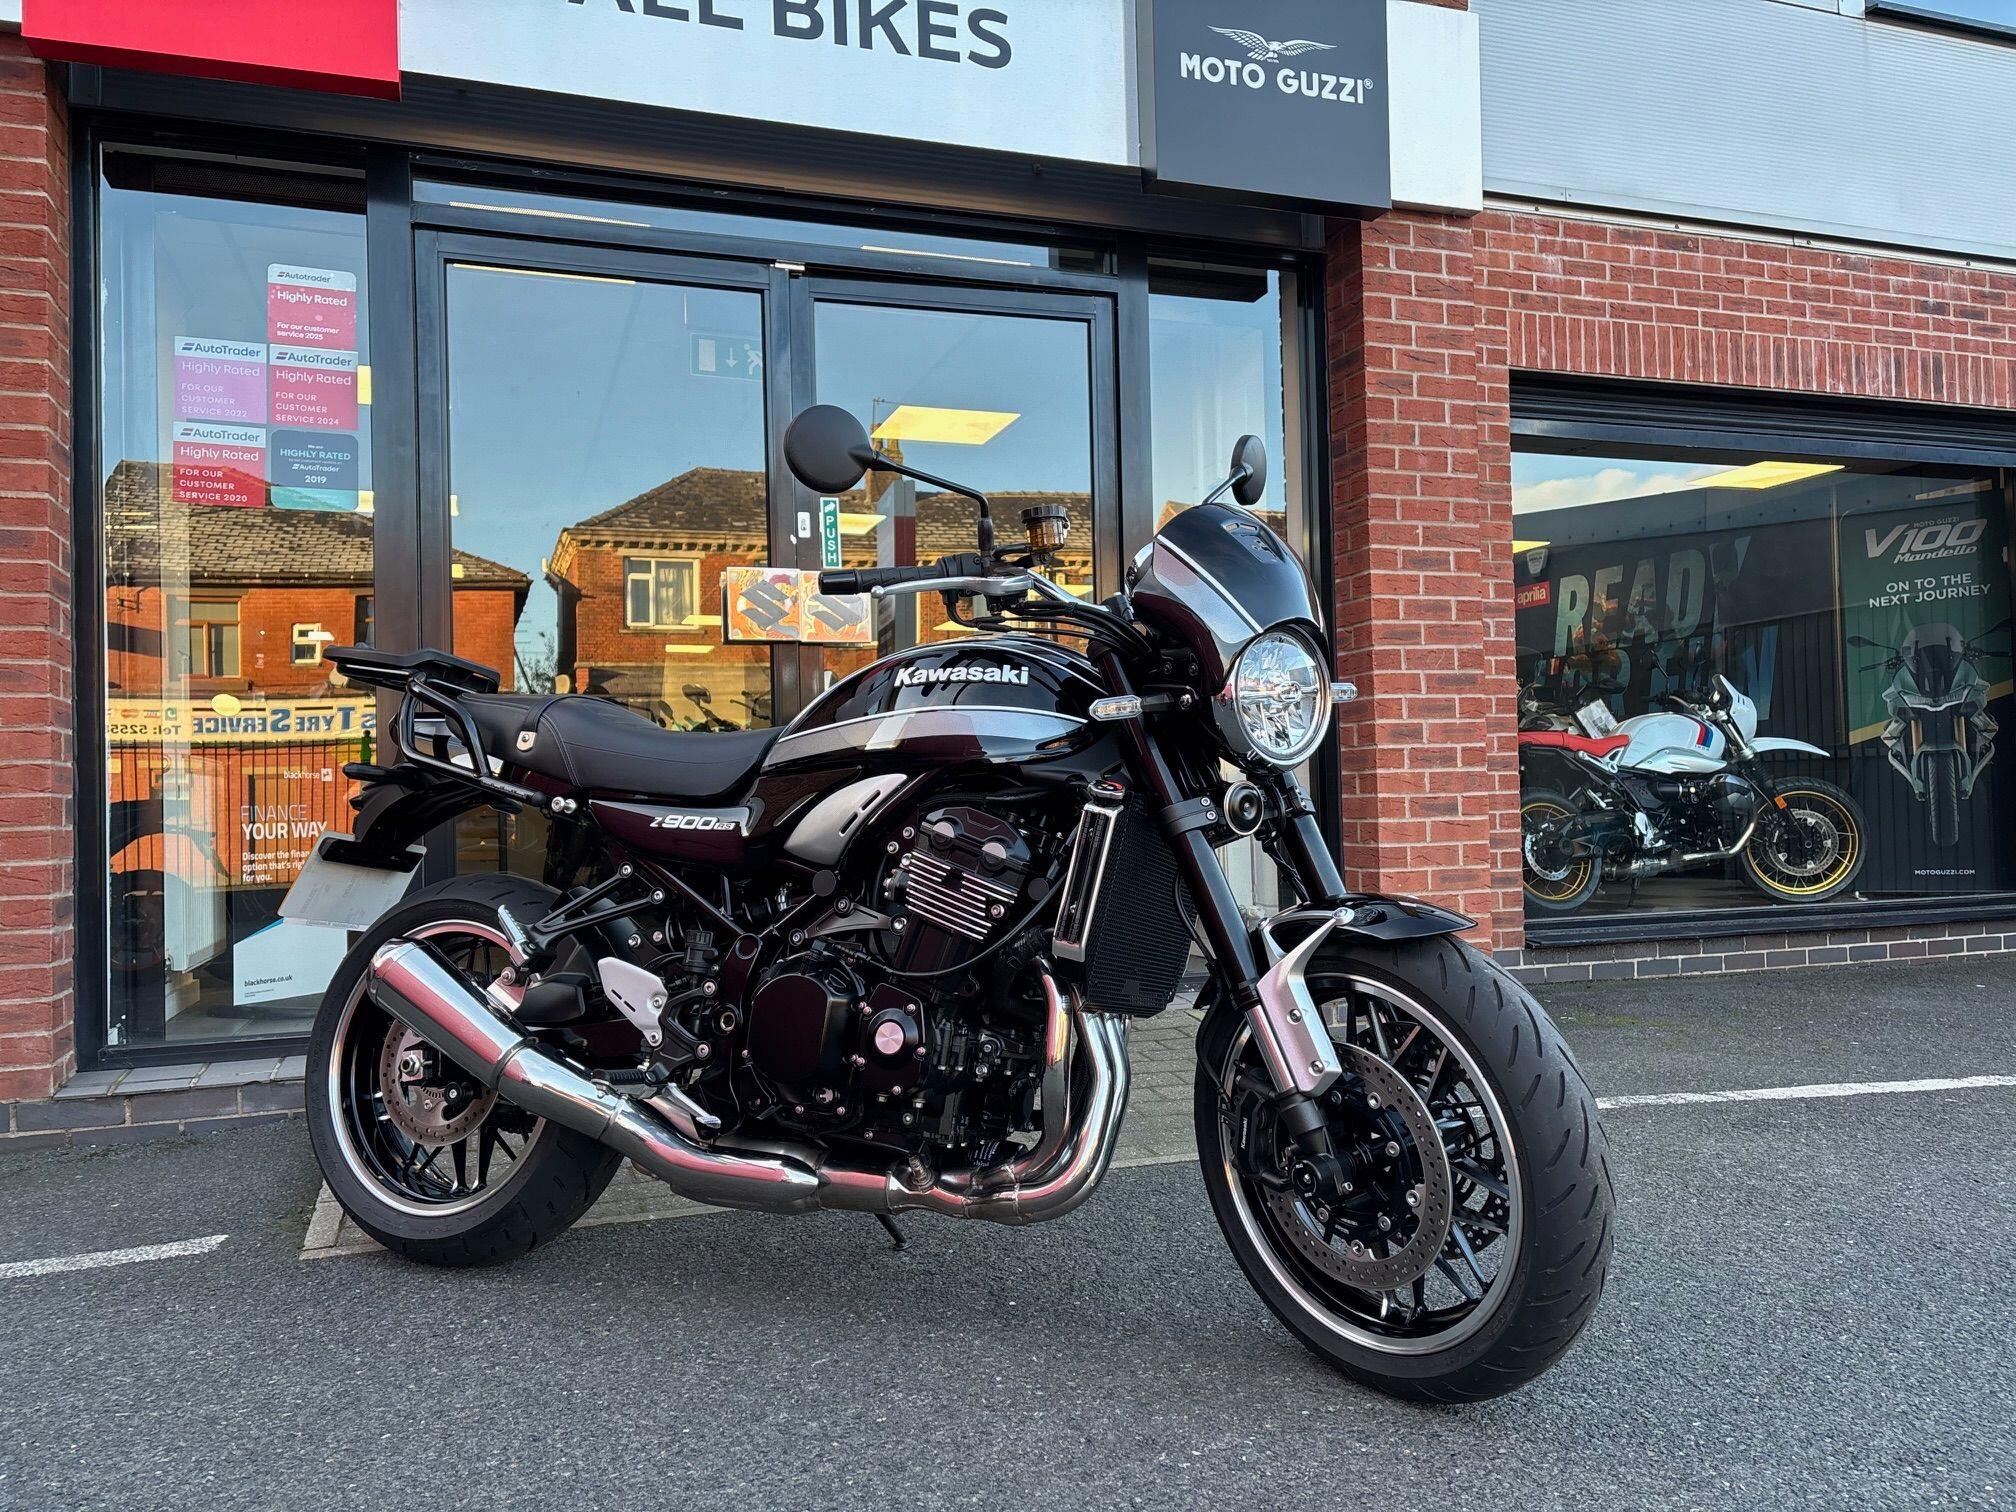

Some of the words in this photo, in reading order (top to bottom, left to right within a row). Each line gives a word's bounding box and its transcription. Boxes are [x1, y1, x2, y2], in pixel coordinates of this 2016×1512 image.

[568, 0, 743, 30] LL
[773, 0, 1012, 69] BIKES
[1180, 52, 1266, 89] MOTO
[285, 272, 331, 283] Autotrader
[277, 290, 313, 304] Highly
[314, 295, 347, 306] Rated
[276, 321, 289, 329] For
[290, 323, 303, 331] our
[304, 324, 339, 334] customer
[276, 330, 304, 338] service
[304, 332, 323, 340] 2025
[194, 343, 261, 357] AutoTrader
[287, 352, 353, 367] AutoTrader
[182, 361, 221, 375] Highly
[223, 364, 260, 377] Rated
[276, 370, 314, 384] Highly
[316, 373, 352, 386] Rated
[181, 383, 201, 391] FOR
[203, 384, 224, 393] OUR
[181, 394, 236, 405] CUSTOMER
[275, 391, 295, 400] FOR
[296, 393, 317, 401] OUR
[181, 405, 221, 415] SERVICE
[224, 408, 248, 417] 2022
[275, 402, 328, 414] CUSTOMER
[275, 413, 315, 424] SERVICE
[317, 417, 339, 425] 2024
[193, 428, 260, 442] AutoTrader
[180, 446, 220, 460] Highly
[222, 449, 259, 461] Rated
[280, 448, 318, 458] HIGHLY
[319, 451, 351, 460] RATED
[179, 468, 200, 476] FOR
[202, 470, 223, 478] OUR
[299, 463, 340, 472] AutoTrader
[179, 479, 235, 490] CUSTOMER
[304, 475, 327, 484] 2019
[179, 490, 221, 500] SERVICE
[223, 493, 248, 502] 2020
[1913, 520, 1935, 528] MOTO
[1936, 517, 1960, 525] GUZZI
[825, 515, 837, 563] PUSH
[1865, 519, 1988, 558] V100
[1893, 545, 1978, 564] Mandello
[1886, 581, 1910, 593] ON
[1914, 577, 1936, 589] TO
[1940, 572, 1972, 586] THE
[1517, 585, 1547, 605] aprilia
[1869, 593, 1910, 608] NEXT
[1915, 584, 1991, 602] JOURNEY
[894, 664, 1029, 688] Kawasaki
[283, 770, 320, 779] blackhorse
[241, 804, 308, 822] FINANCE
[241, 822, 289, 840] YOUR
[291, 821, 328, 838] WAY
[242, 851, 275, 861] Discover
[276, 850, 290, 859] the
[242, 862, 268, 873] option
[268, 860, 291, 870] that's
[292, 860, 305, 870] rig
[242, 873, 255, 882] for
[255, 874, 273, 883] you.
[244, 974, 293, 987] blackhorse.co.uk
